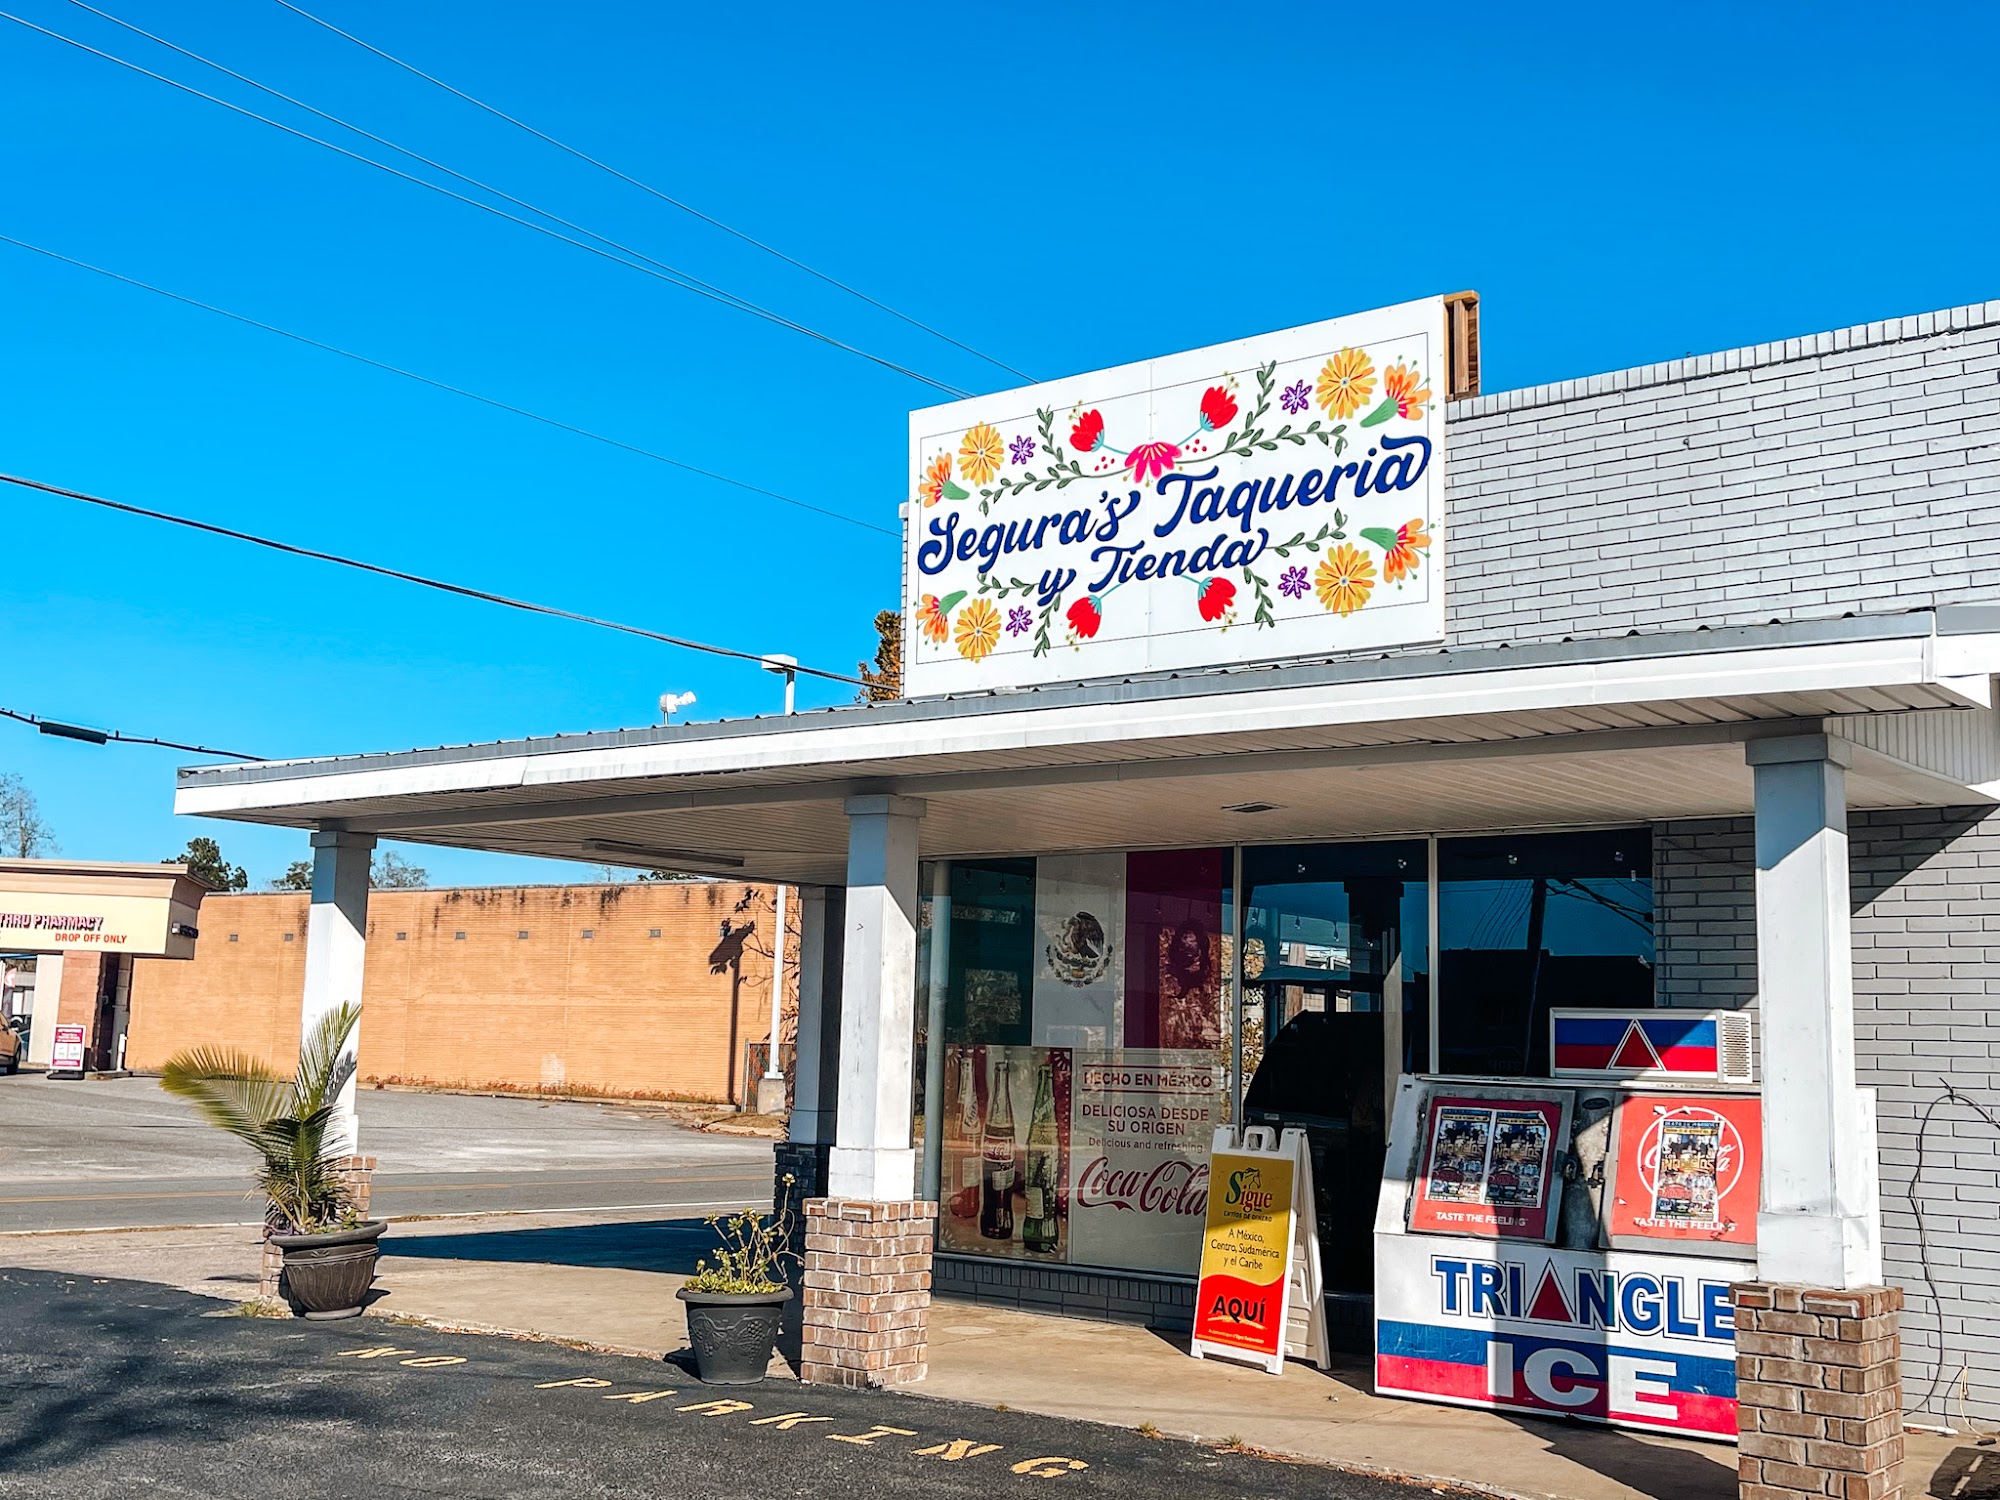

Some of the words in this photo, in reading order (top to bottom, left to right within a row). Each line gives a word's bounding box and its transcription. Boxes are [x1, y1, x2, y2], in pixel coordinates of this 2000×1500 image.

[918, 489, 1140, 575] Segura's
[1153, 434, 1432, 538] Taqueria
[1036, 567, 1076, 607] y
[1088, 528, 1269, 593] Tienda
[33, 914, 104, 931] PHARMACY
[55, 933, 81, 942] DROP
[83, 933, 101, 943] OFF
[103, 935, 127, 944] ONLY
[1084, 1072, 1131, 1085] HECHO
[1135, 1073, 1153, 1086] EN
[1157, 1073, 1212, 1088] MÉXICO
[1082, 1104, 1156, 1119] DELICIOSA
[1161, 1107, 1209, 1121] DESDE
[1108, 1120, 1126, 1132] SU
[1130, 1121, 1185, 1135] ORIGEN
[1088, 1137, 1131, 1148] Delicious
[1134, 1140, 1151, 1150] and
[1226, 1171, 1273, 1212] Sigue
[1436, 1211, 1464, 1222] TASTE
[1466, 1213, 1484, 1223] THE
[1485, 1215, 1526, 1227] FEELING
[1633, 1217, 1666, 1228] TASTE
[1668, 1219, 1689, 1229] THE
[1228, 1228, 1234, 1238] A
[1237, 1229, 1264, 1243] México,
[1238, 1243, 1280, 1258] Sudamérica
[1223, 1256, 1228, 1267] y
[1230, 1256, 1237, 1265] el
[1239, 1256, 1263, 1269] Caribe
[1431, 1255, 1735, 1344] TRIANGLE
[1212, 1296, 1267, 1323] AQUÍ
[1487, 1340, 1679, 1421] ICE
[337, 1347, 467, 1367] NO
[534, 1376, 1090, 1479] PARKING
